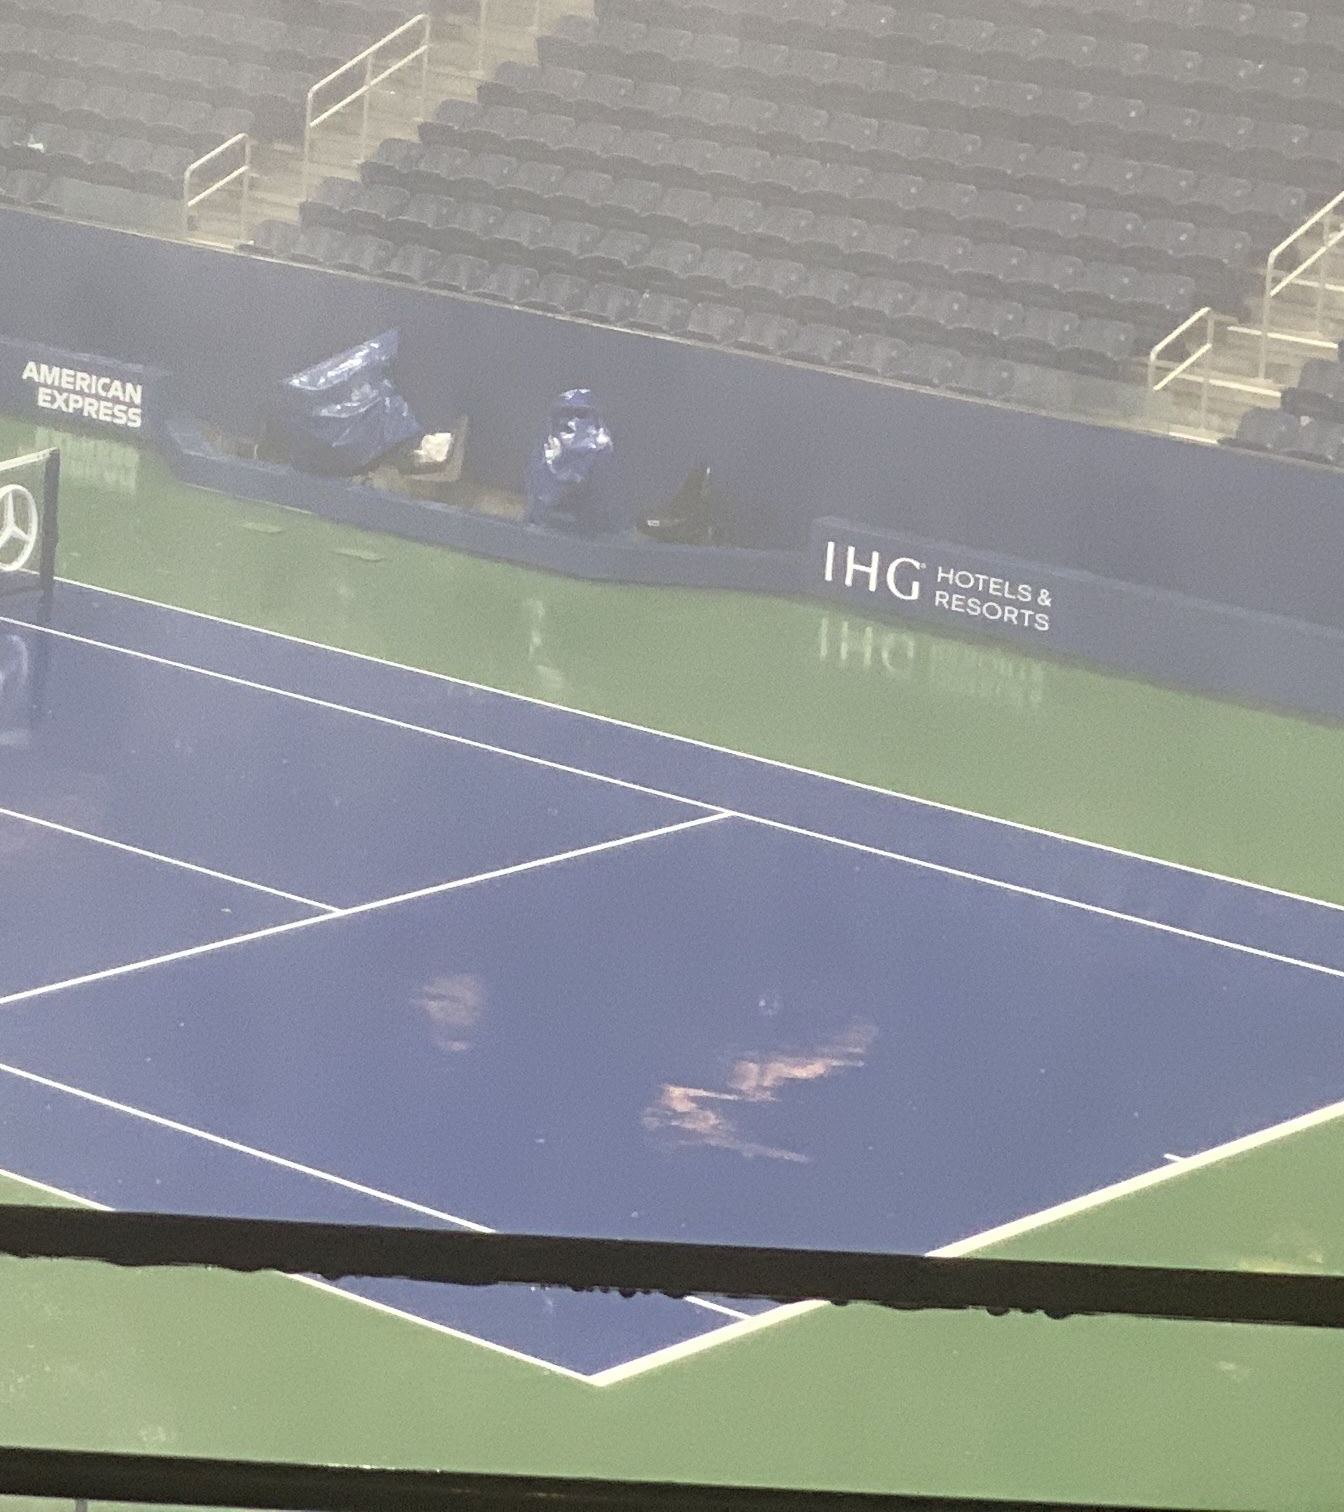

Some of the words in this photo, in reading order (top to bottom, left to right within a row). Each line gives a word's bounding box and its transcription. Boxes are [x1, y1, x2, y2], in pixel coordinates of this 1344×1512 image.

[22, 361, 143, 405] AMERICAN
[38, 387, 142, 428] EXPRESS
[825, 541, 922, 600] IHG
[937, 566, 1032, 602] HOTELS
[1037, 588, 1053, 607] &
[934, 590, 1050, 631] RESORTS
